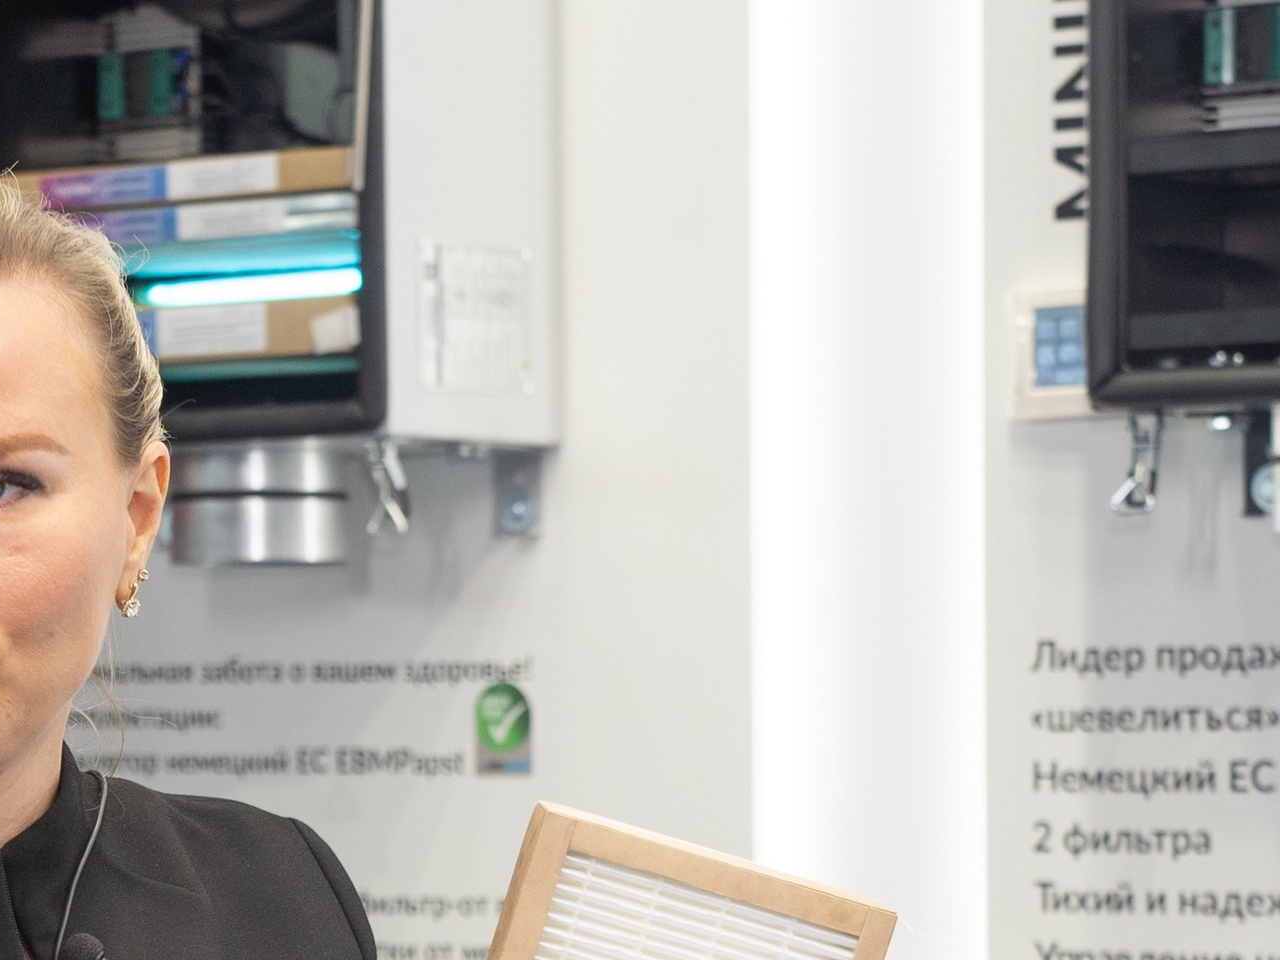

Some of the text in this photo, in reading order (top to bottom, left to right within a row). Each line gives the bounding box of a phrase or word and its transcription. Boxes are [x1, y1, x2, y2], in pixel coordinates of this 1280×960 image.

[1053, 0, 1087, 219] MINI
[200, 655, 283, 685] забота
[290, 662, 310, 684] о
[313, 661, 396, 684] вашем
[1031, 639, 1144, 678] Лидер
[166, 747, 289, 779] немецкий
[1033, 759, 1216, 798] Немецкий
[1033, 820, 1213, 861] 2 фильтра
[1035, 881, 1136, 915] Тихий
[1146, 891, 1168, 915] и
